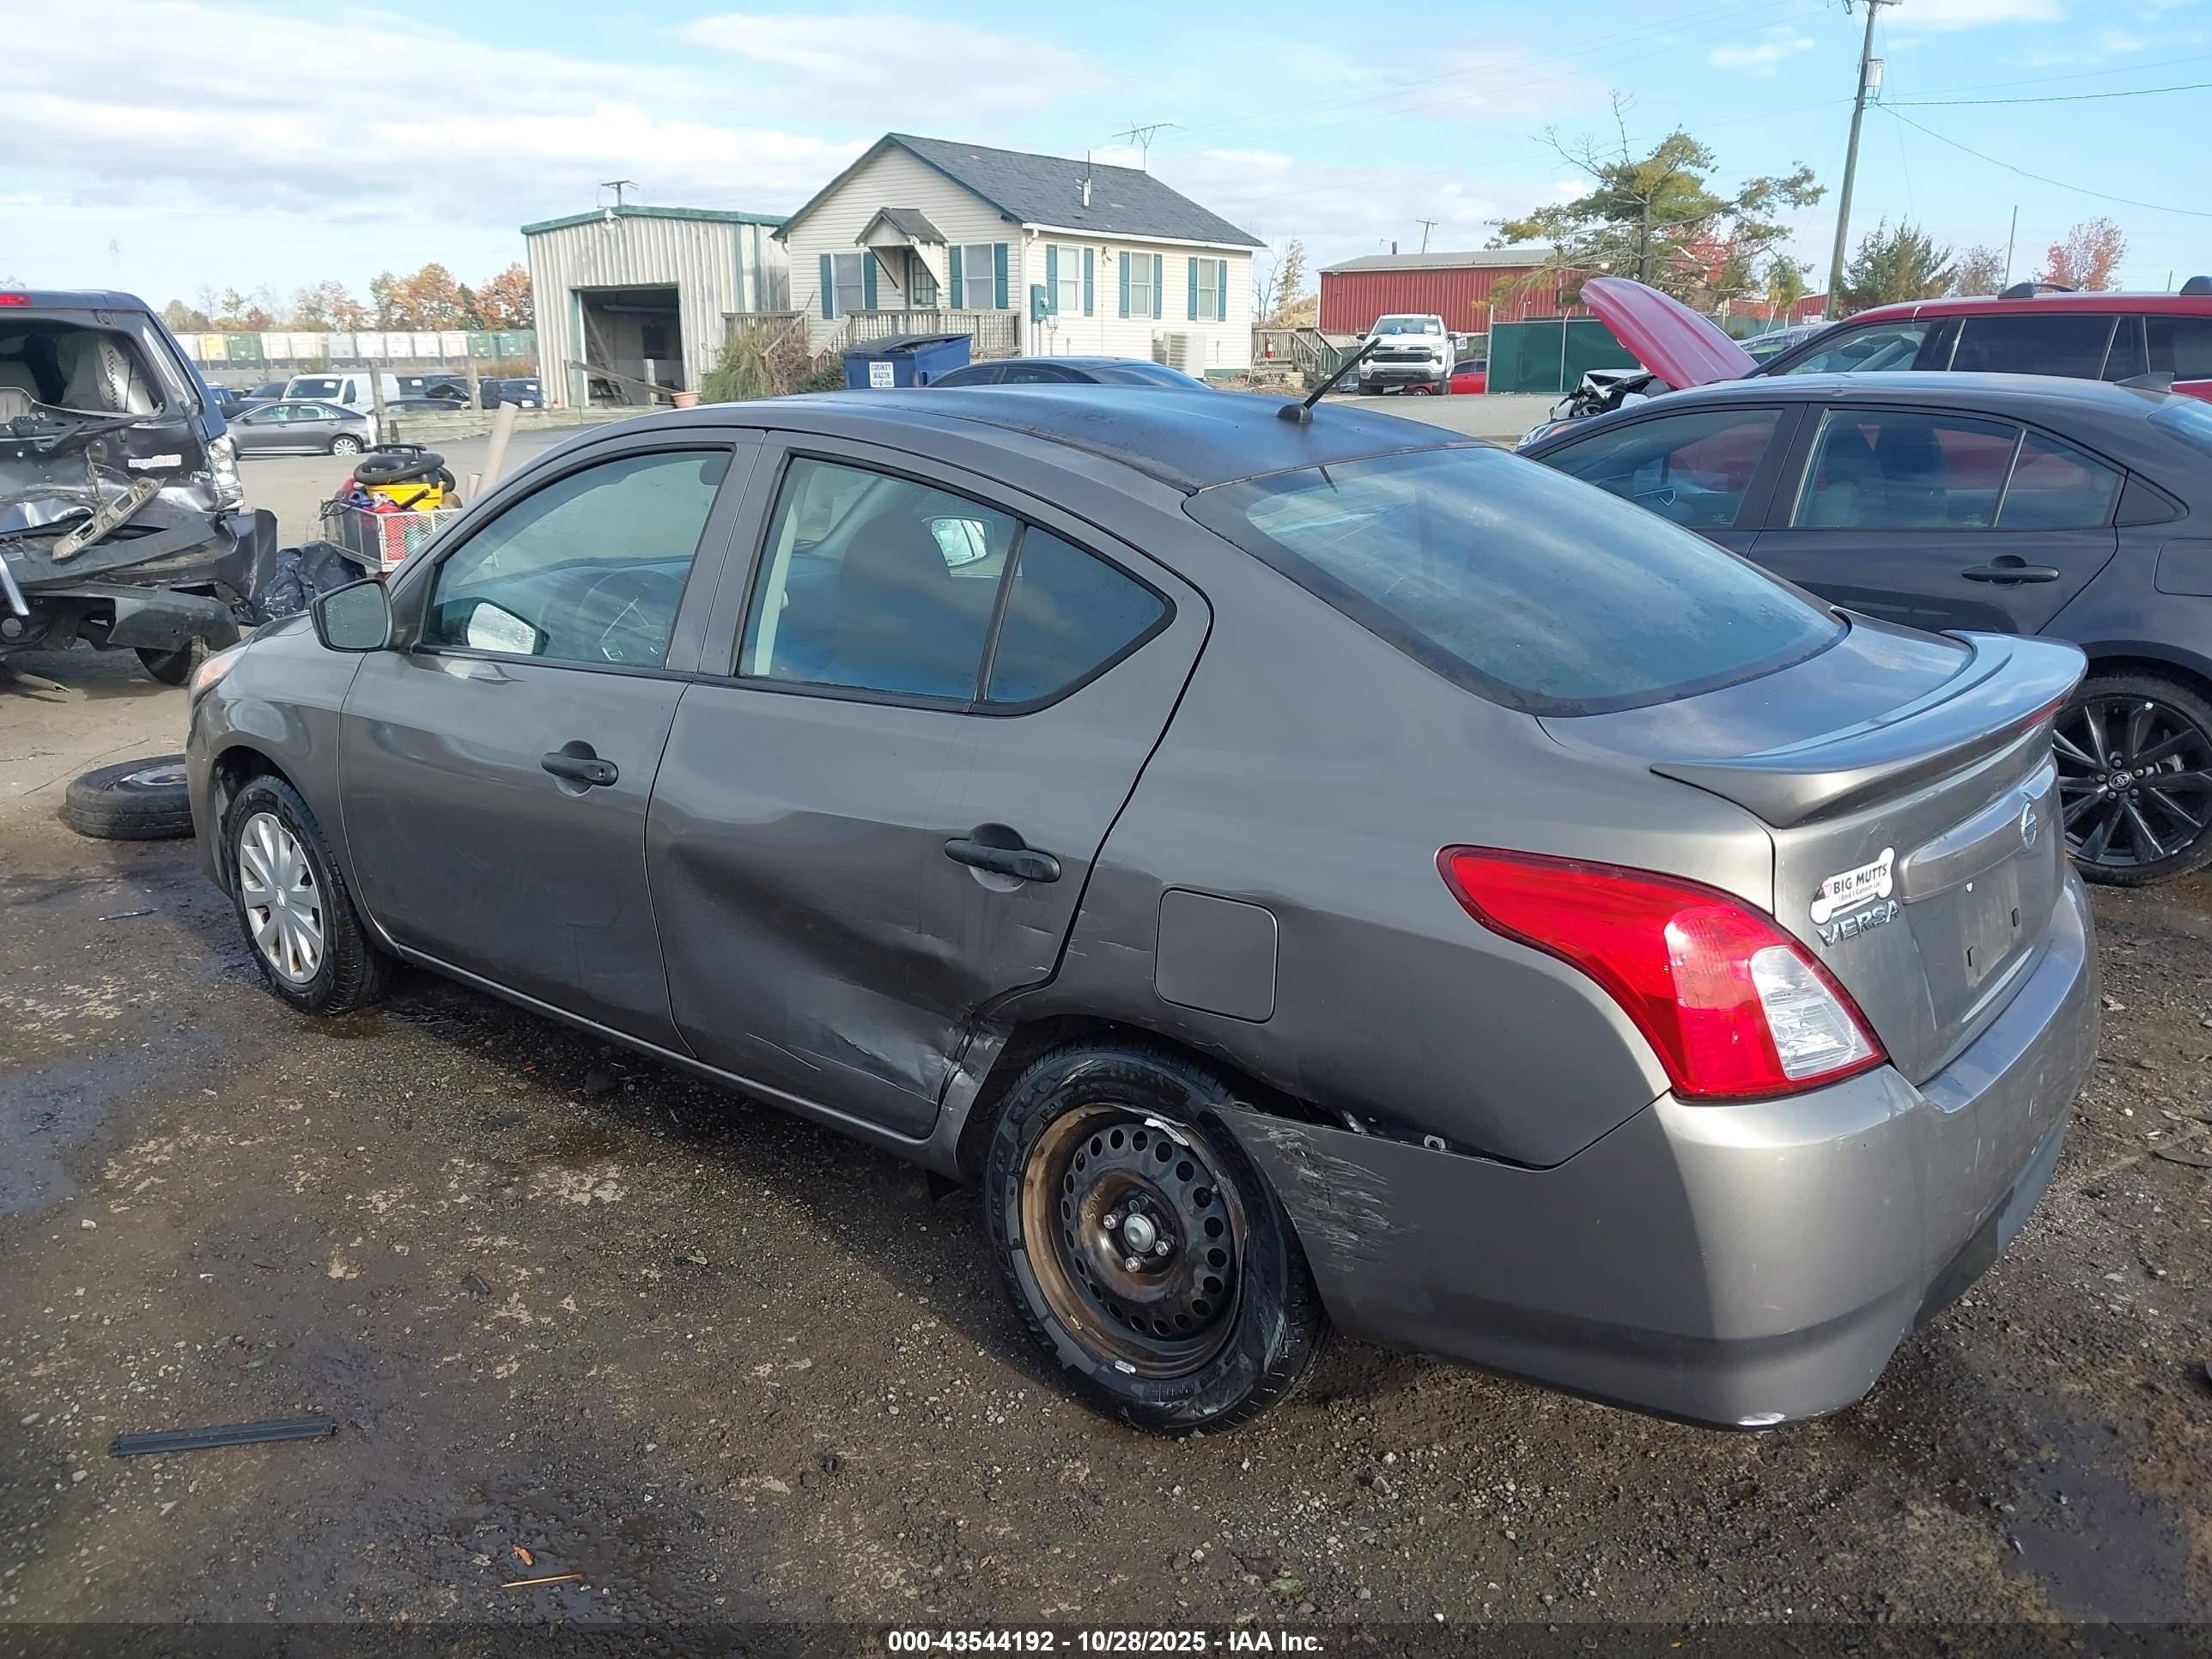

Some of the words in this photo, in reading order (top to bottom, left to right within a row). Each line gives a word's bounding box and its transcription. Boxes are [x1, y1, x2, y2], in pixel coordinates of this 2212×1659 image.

[1833, 877, 1852, 895] BIG
[1856, 862, 1887, 886] MUTTS
[1816, 899, 1899, 947] VERSA
